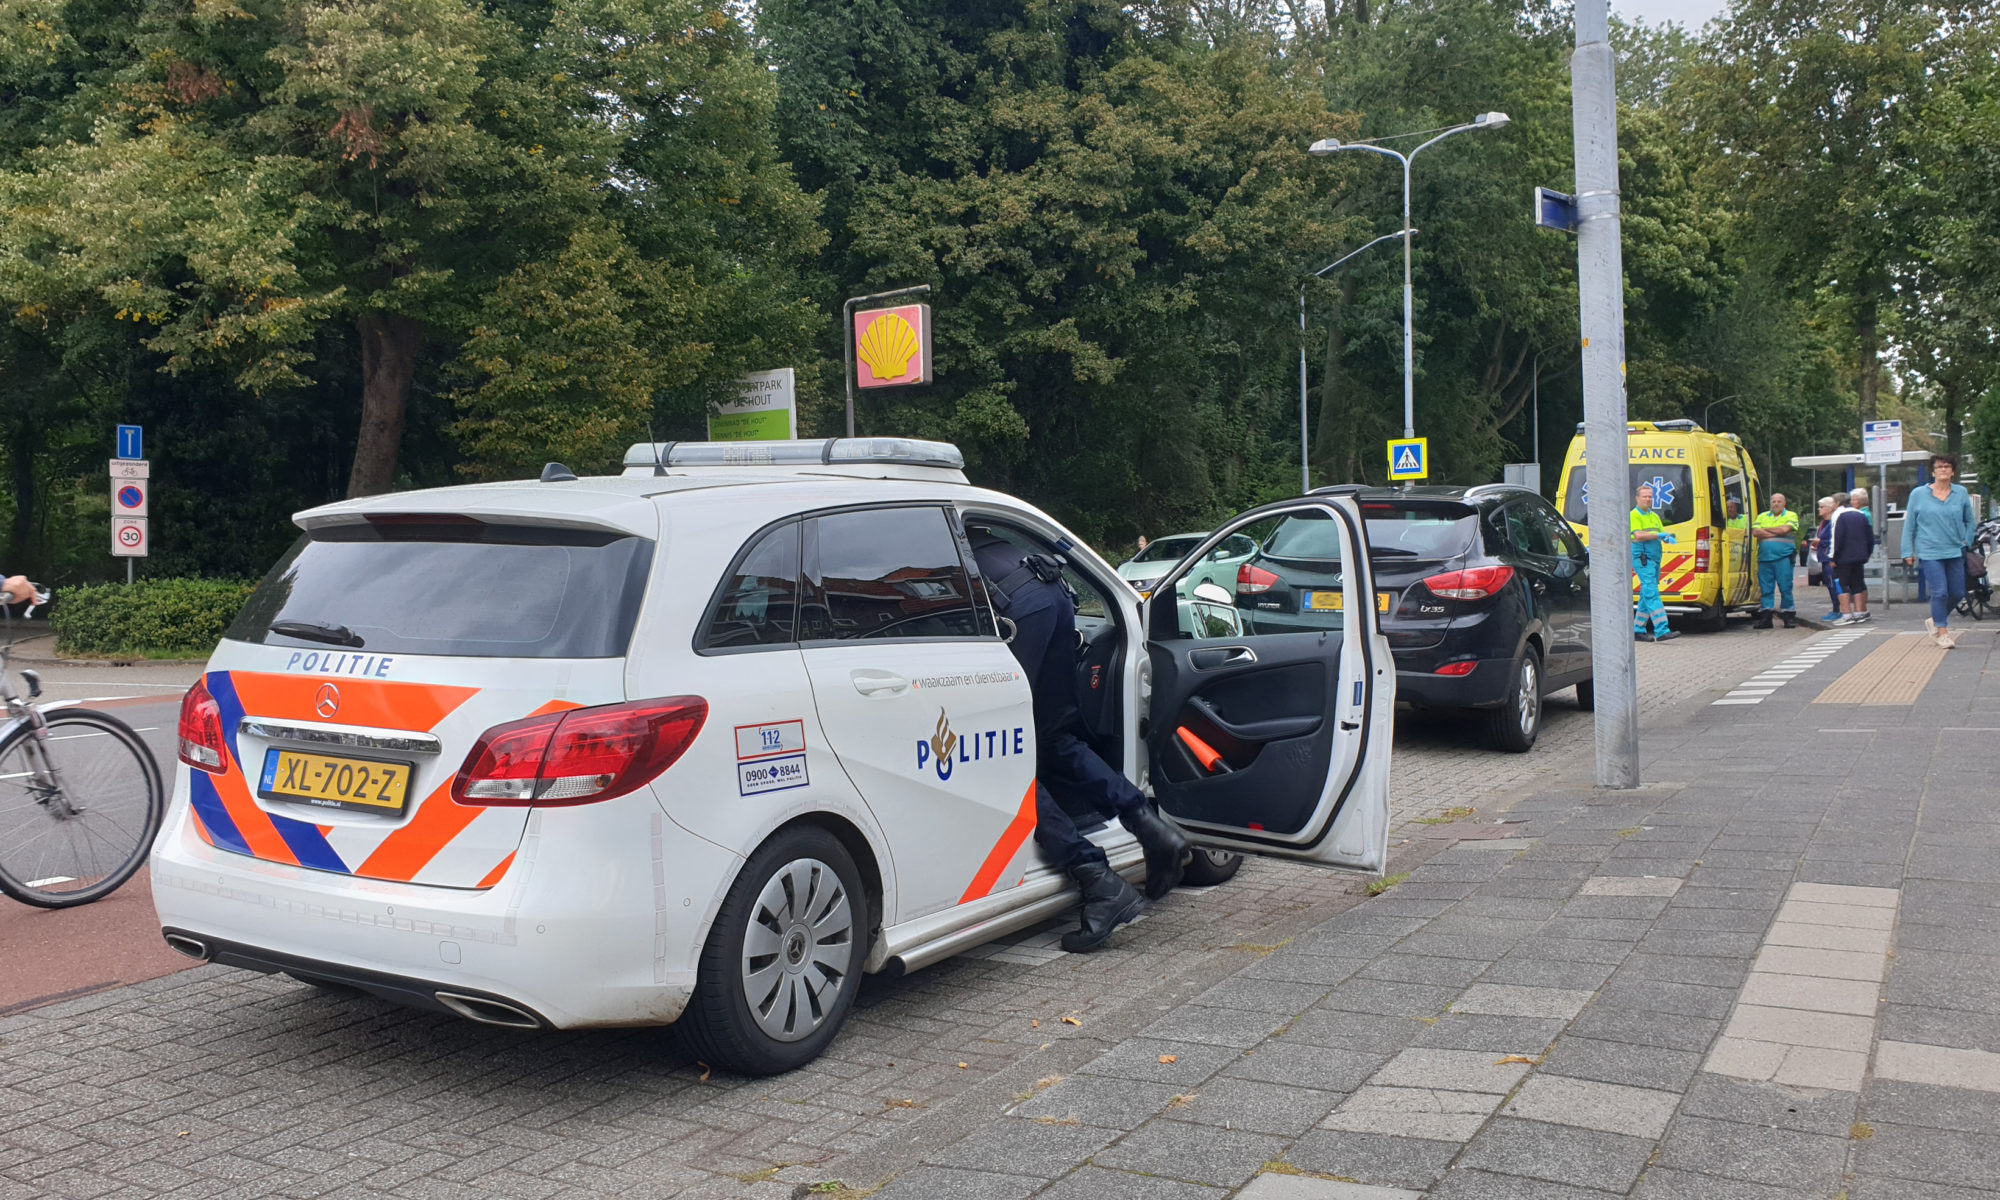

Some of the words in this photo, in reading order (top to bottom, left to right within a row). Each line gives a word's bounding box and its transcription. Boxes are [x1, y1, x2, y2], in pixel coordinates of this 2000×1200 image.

[748, 394, 771, 406] HOUT
[123, 532, 138, 541] 30
[286, 652, 393, 678] POLITIE
[963, 675, 973, 686] en
[916, 727, 1023, 781] POLITIE
[263, 774, 273, 785] NL
[282, 758, 396, 802] XL-702-Z
[745, 768, 767, 782] 0900
[780, 764, 800, 776] 8844
